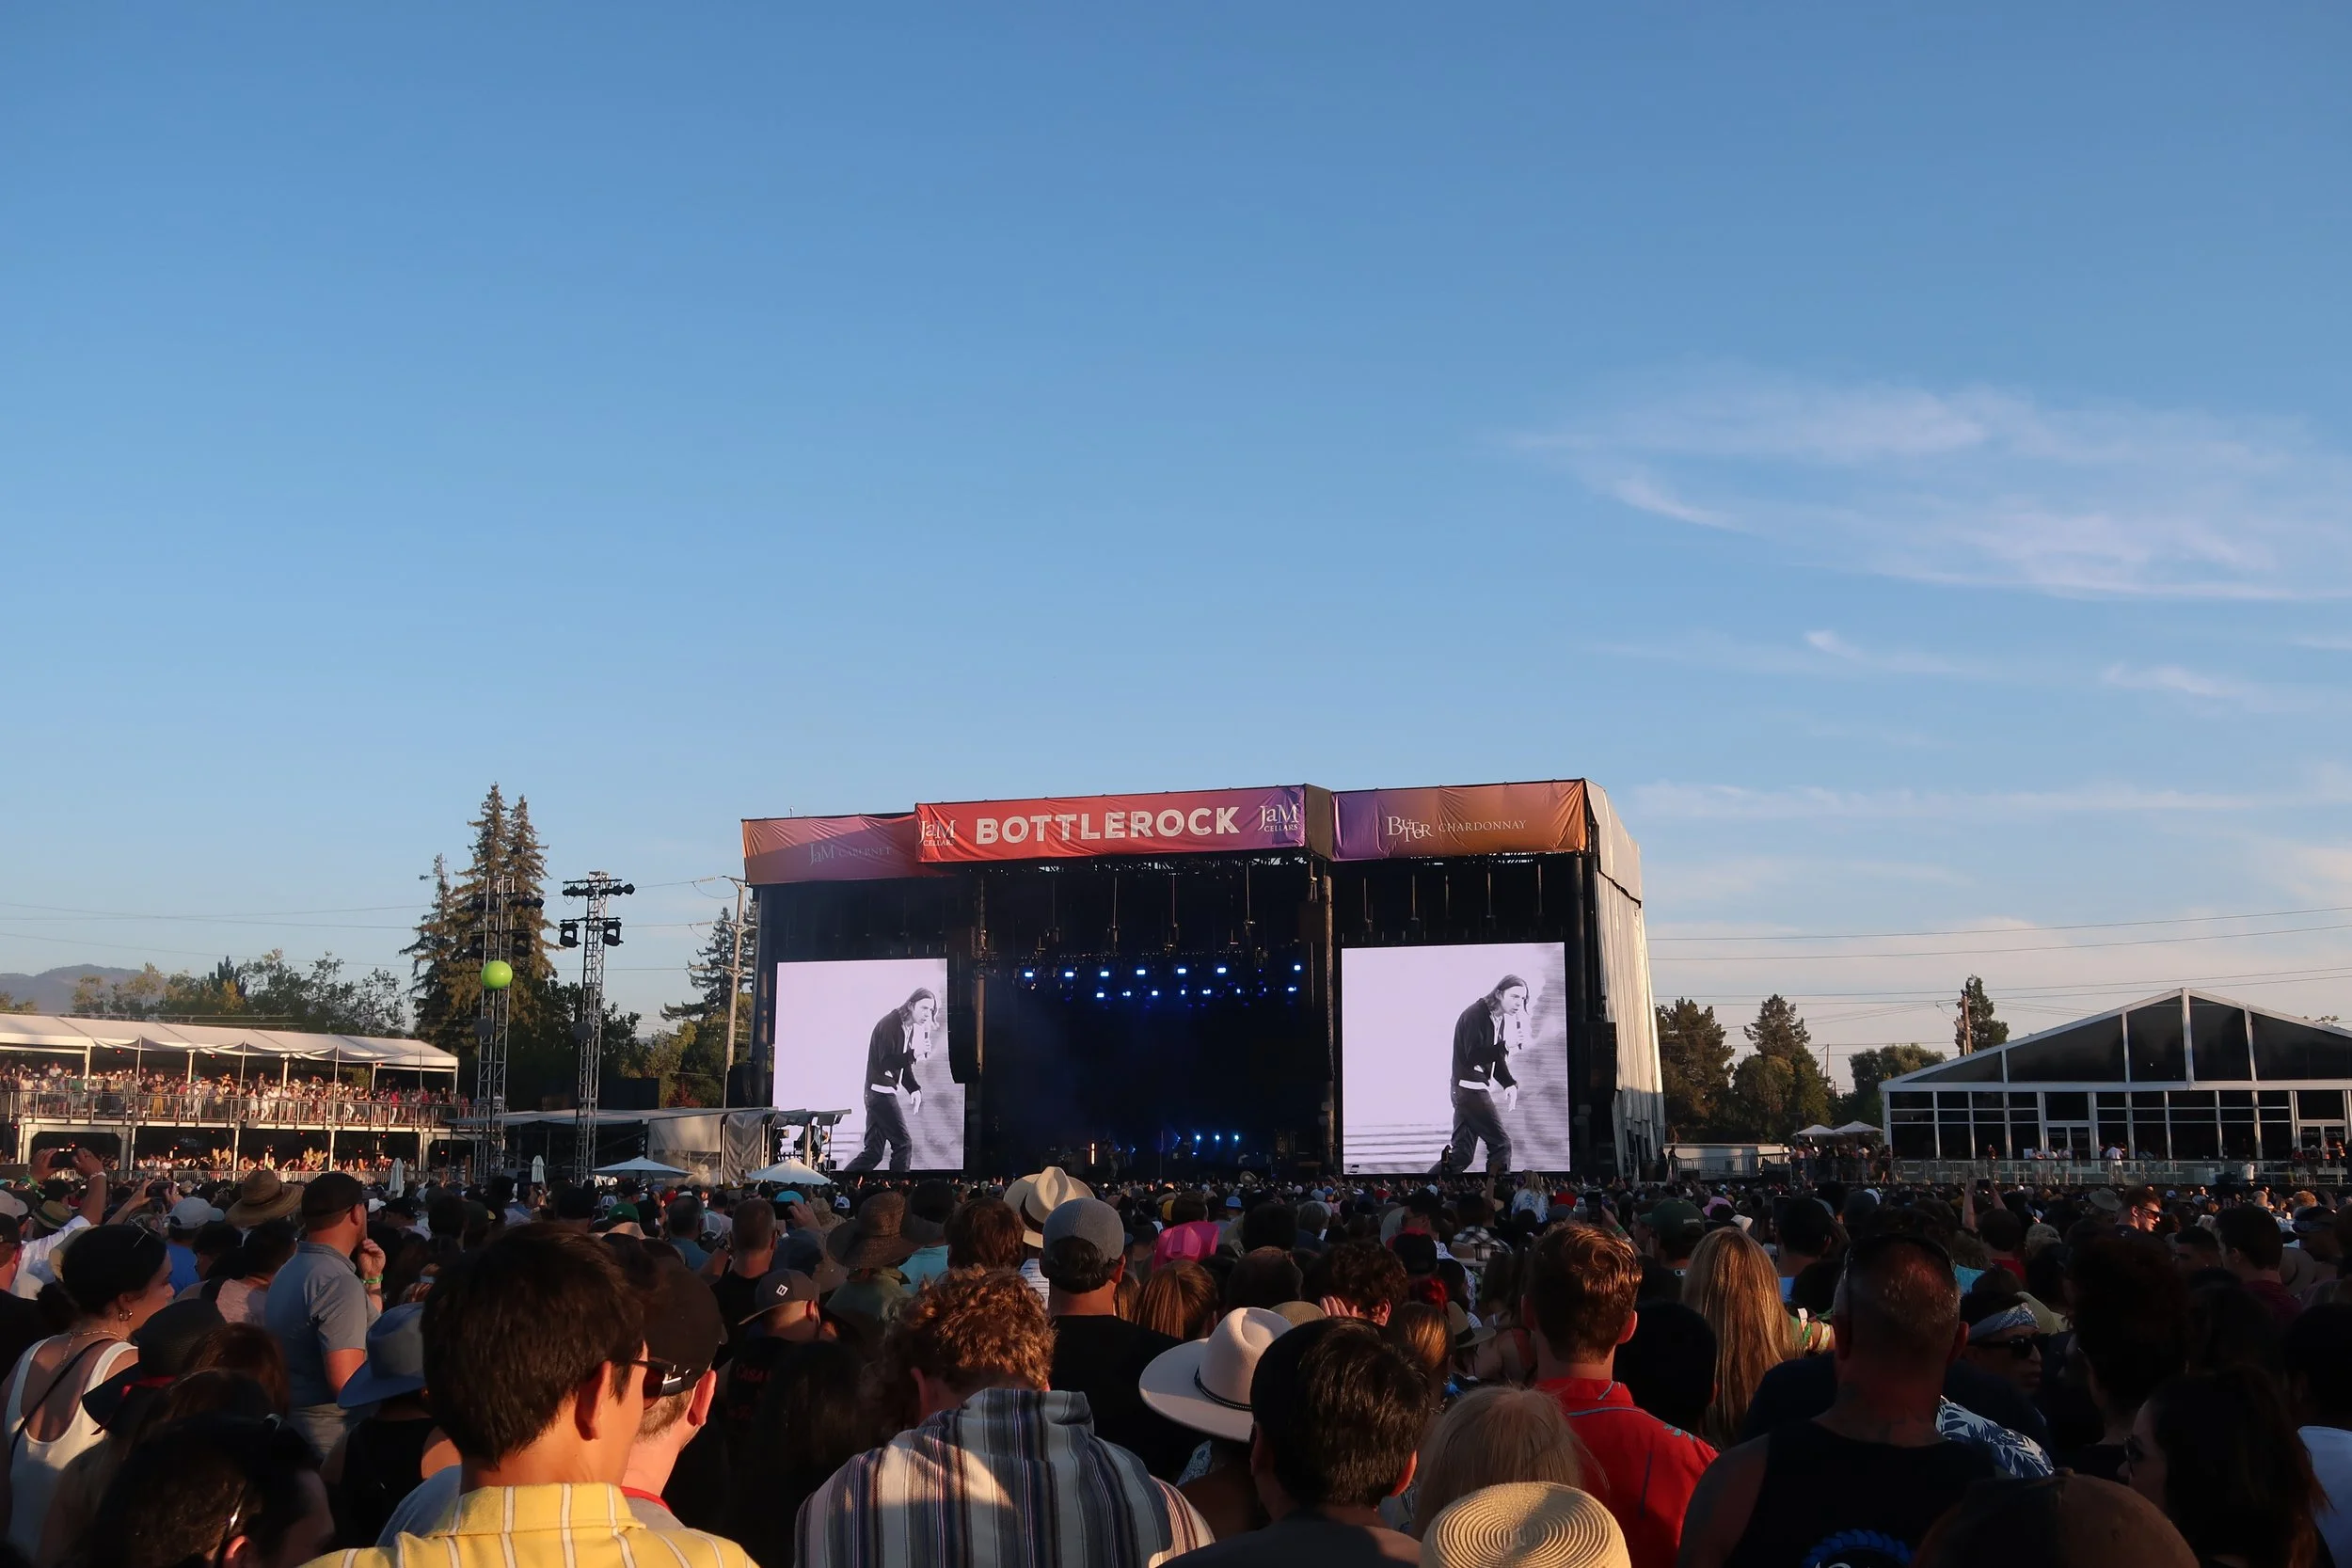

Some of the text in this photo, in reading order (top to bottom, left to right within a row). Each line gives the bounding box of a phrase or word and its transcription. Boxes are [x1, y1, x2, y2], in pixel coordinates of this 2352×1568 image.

[976, 806, 1241, 845] BOTTLEROCK
[1258, 803, 1299, 832] JaM
[1263, 824, 1298, 832] CELLARS
[1438, 820, 1527, 833] CHARDONNAY
